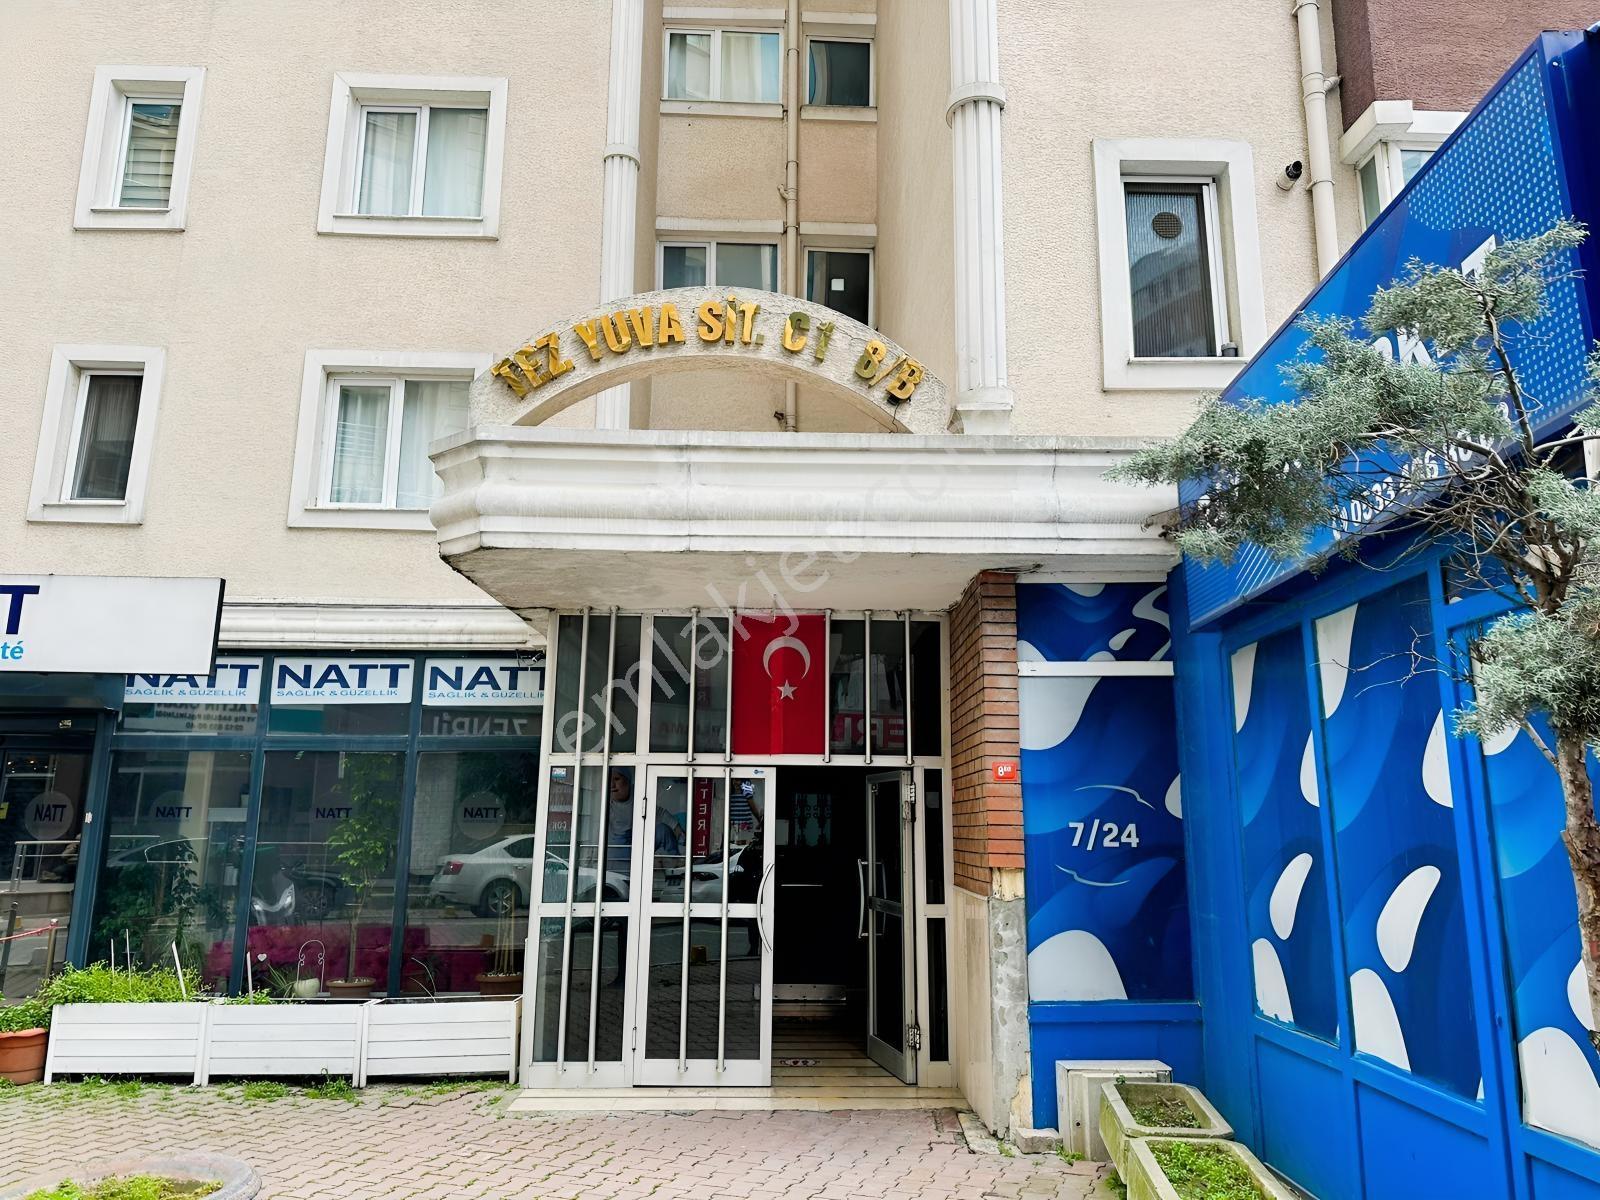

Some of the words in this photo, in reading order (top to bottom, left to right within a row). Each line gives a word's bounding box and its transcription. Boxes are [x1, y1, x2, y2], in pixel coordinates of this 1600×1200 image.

[490, 332, 575, 400] TEZ
[572, 302, 686, 361] YUVA
[697, 294, 764, 346] SİT.
[0, 585, 40, 635] T
[0, 640, 24, 660] té
[126, 664, 260, 689] NATT
[277, 664, 410, 689] NATT
[428, 666, 546, 691] NATT
[329, 689, 338, 697] &
[33, 804, 67, 822] NATT
[155, 806, 192, 818] NATT
[315, 807, 352, 819] NATT
[463, 807, 500, 819] NATT
[1068, 818, 1140, 851] 7/24
